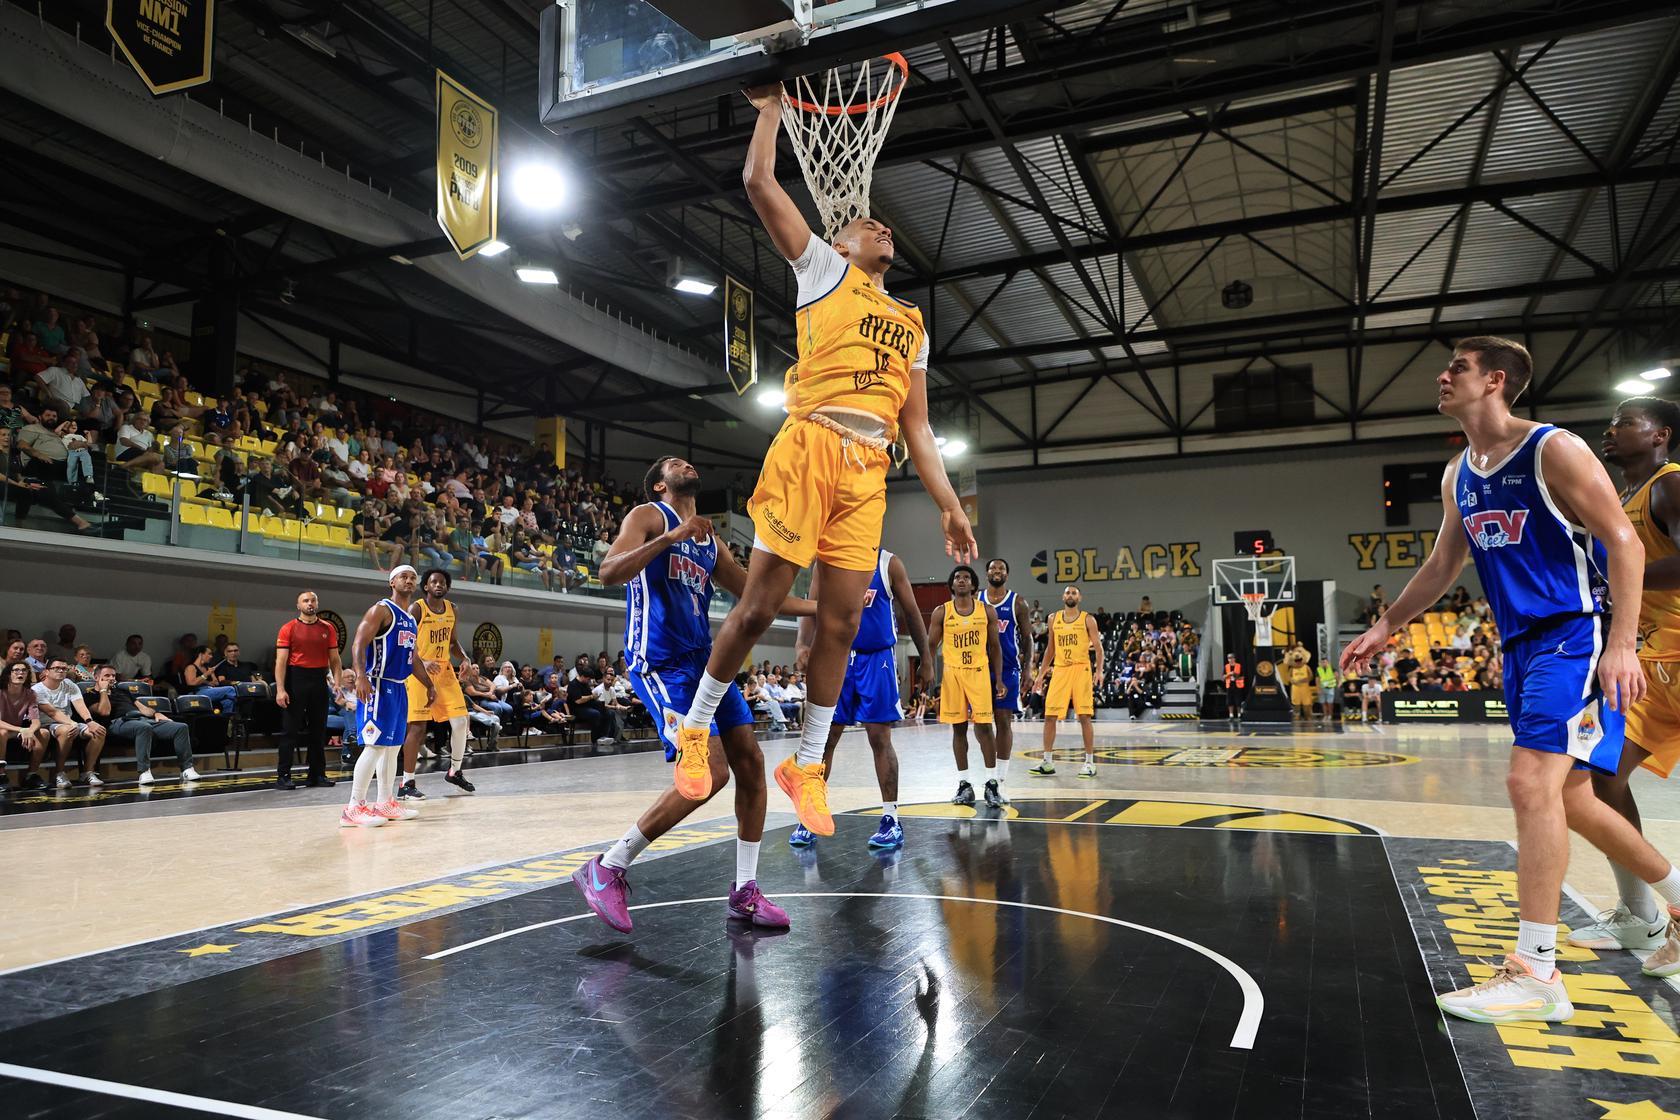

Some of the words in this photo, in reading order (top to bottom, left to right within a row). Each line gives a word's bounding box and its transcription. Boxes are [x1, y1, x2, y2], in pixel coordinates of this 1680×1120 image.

[139, 0, 180, 36] NM1
[136, 20, 181, 50] VICE-CHAMPION
[144, 34, 151, 45] DE
[151, 39, 174, 57] FRANCE
[454, 153, 478, 178] 2009
[859, 313, 914, 359] BYERS
[1254, 540, 1264, 553] 5
[1054, 541, 1202, 584] BLACK
[953, 630, 980, 649] BYERS
[1057, 633, 1079, 647] BYERS
[962, 651, 973, 665] 85
[1064, 649, 1073, 660] 22
